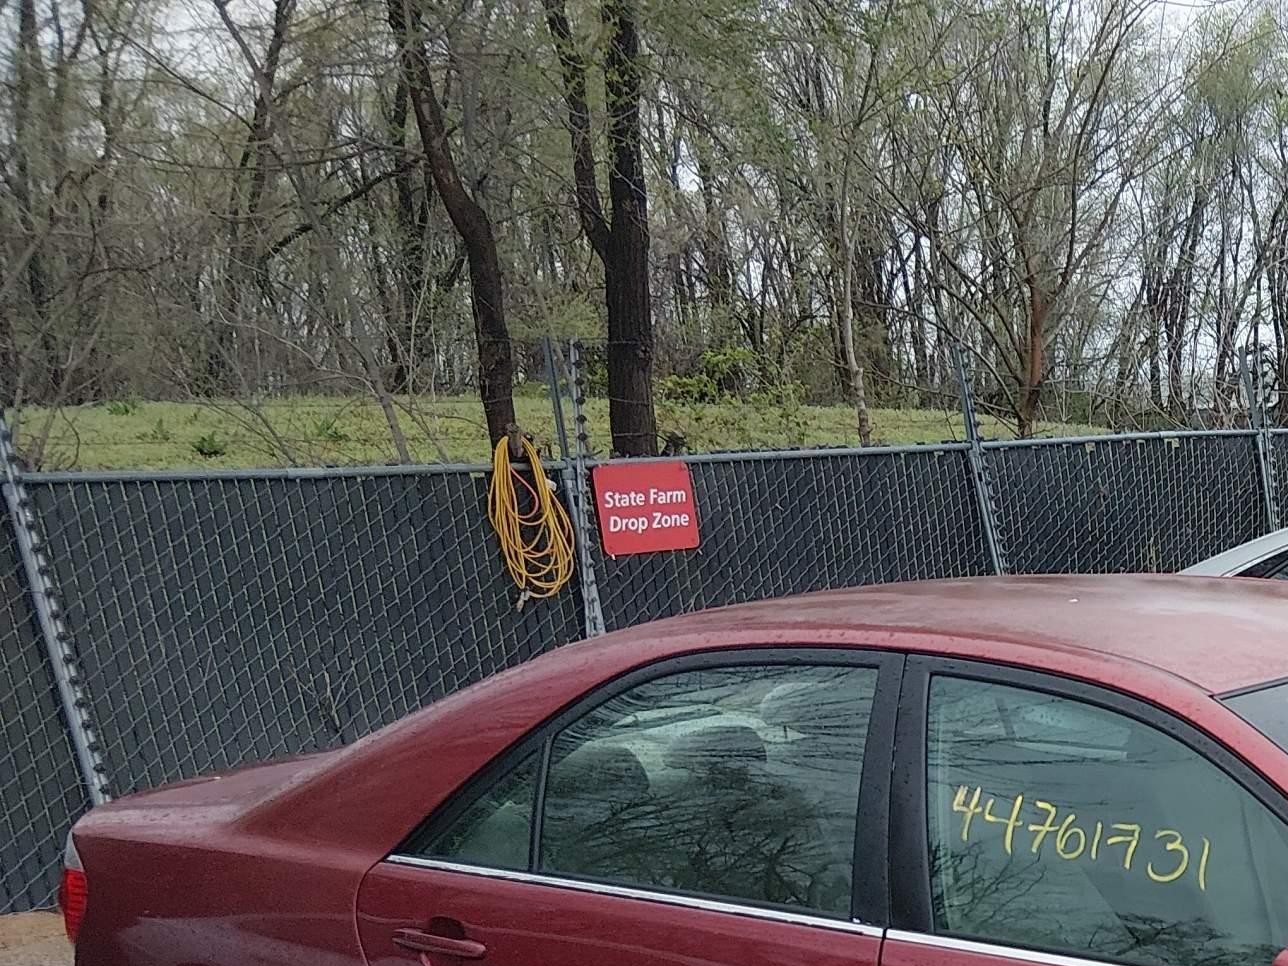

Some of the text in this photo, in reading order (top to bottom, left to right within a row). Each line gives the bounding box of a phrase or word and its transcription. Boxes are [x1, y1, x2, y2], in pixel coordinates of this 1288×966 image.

[604, 488, 686, 508] State Farm
[609, 512, 689, 533] Drop Zone
[952, 784, 1211, 892] 44761731
